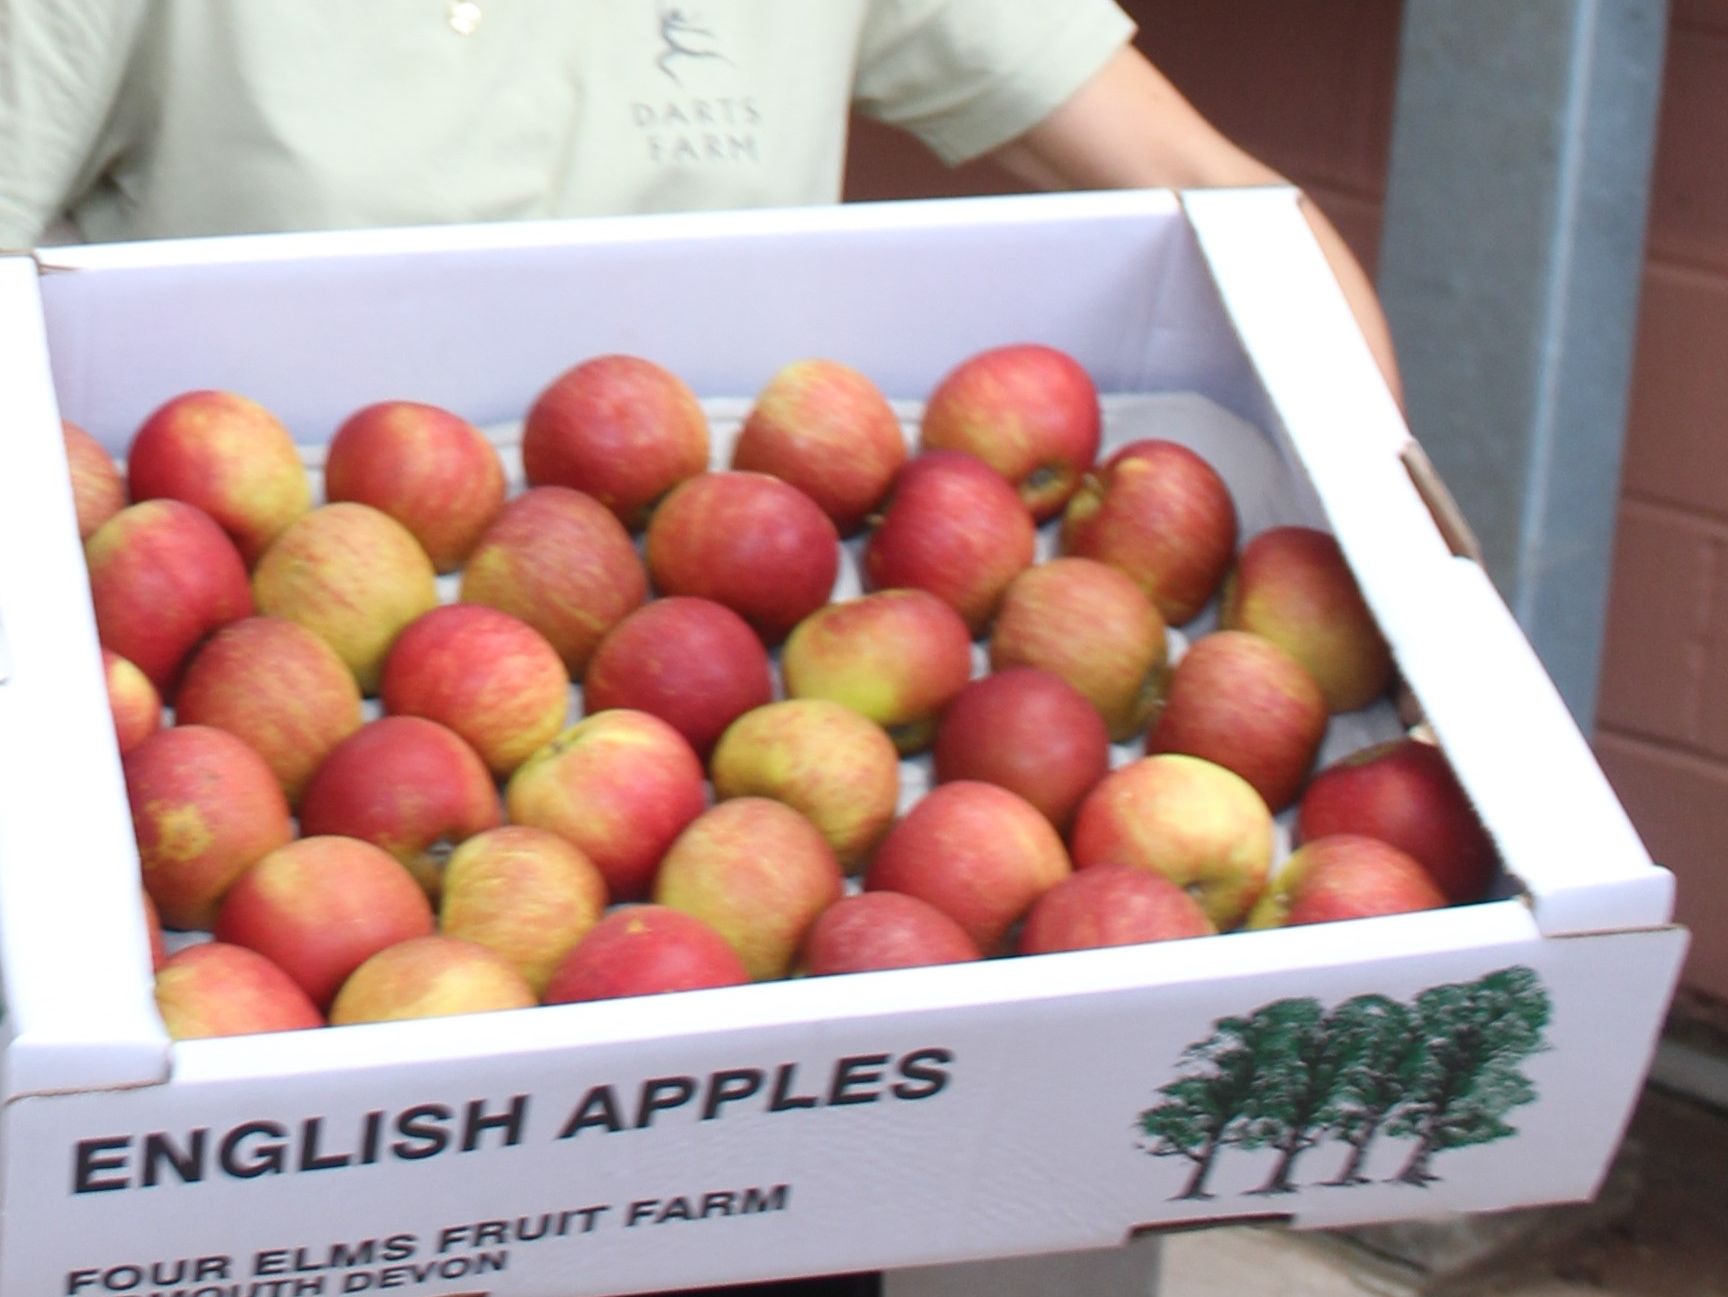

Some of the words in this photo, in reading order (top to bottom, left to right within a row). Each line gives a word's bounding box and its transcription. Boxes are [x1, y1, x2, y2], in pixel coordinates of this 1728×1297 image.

[629, 97, 763, 128] DARTS
[647, 131, 761, 164] FARM
[72, 1095, 530, 1196] ENGLISH
[557, 1048, 954, 1141] APPLES
[65, 1254, 233, 1297] FOUR
[251, 1234, 418, 1278] ELMS
[435, 1205, 612, 1255] FRUIT
[624, 1184, 791, 1228] FARM
[340, 1250, 509, 1295] DEVON
